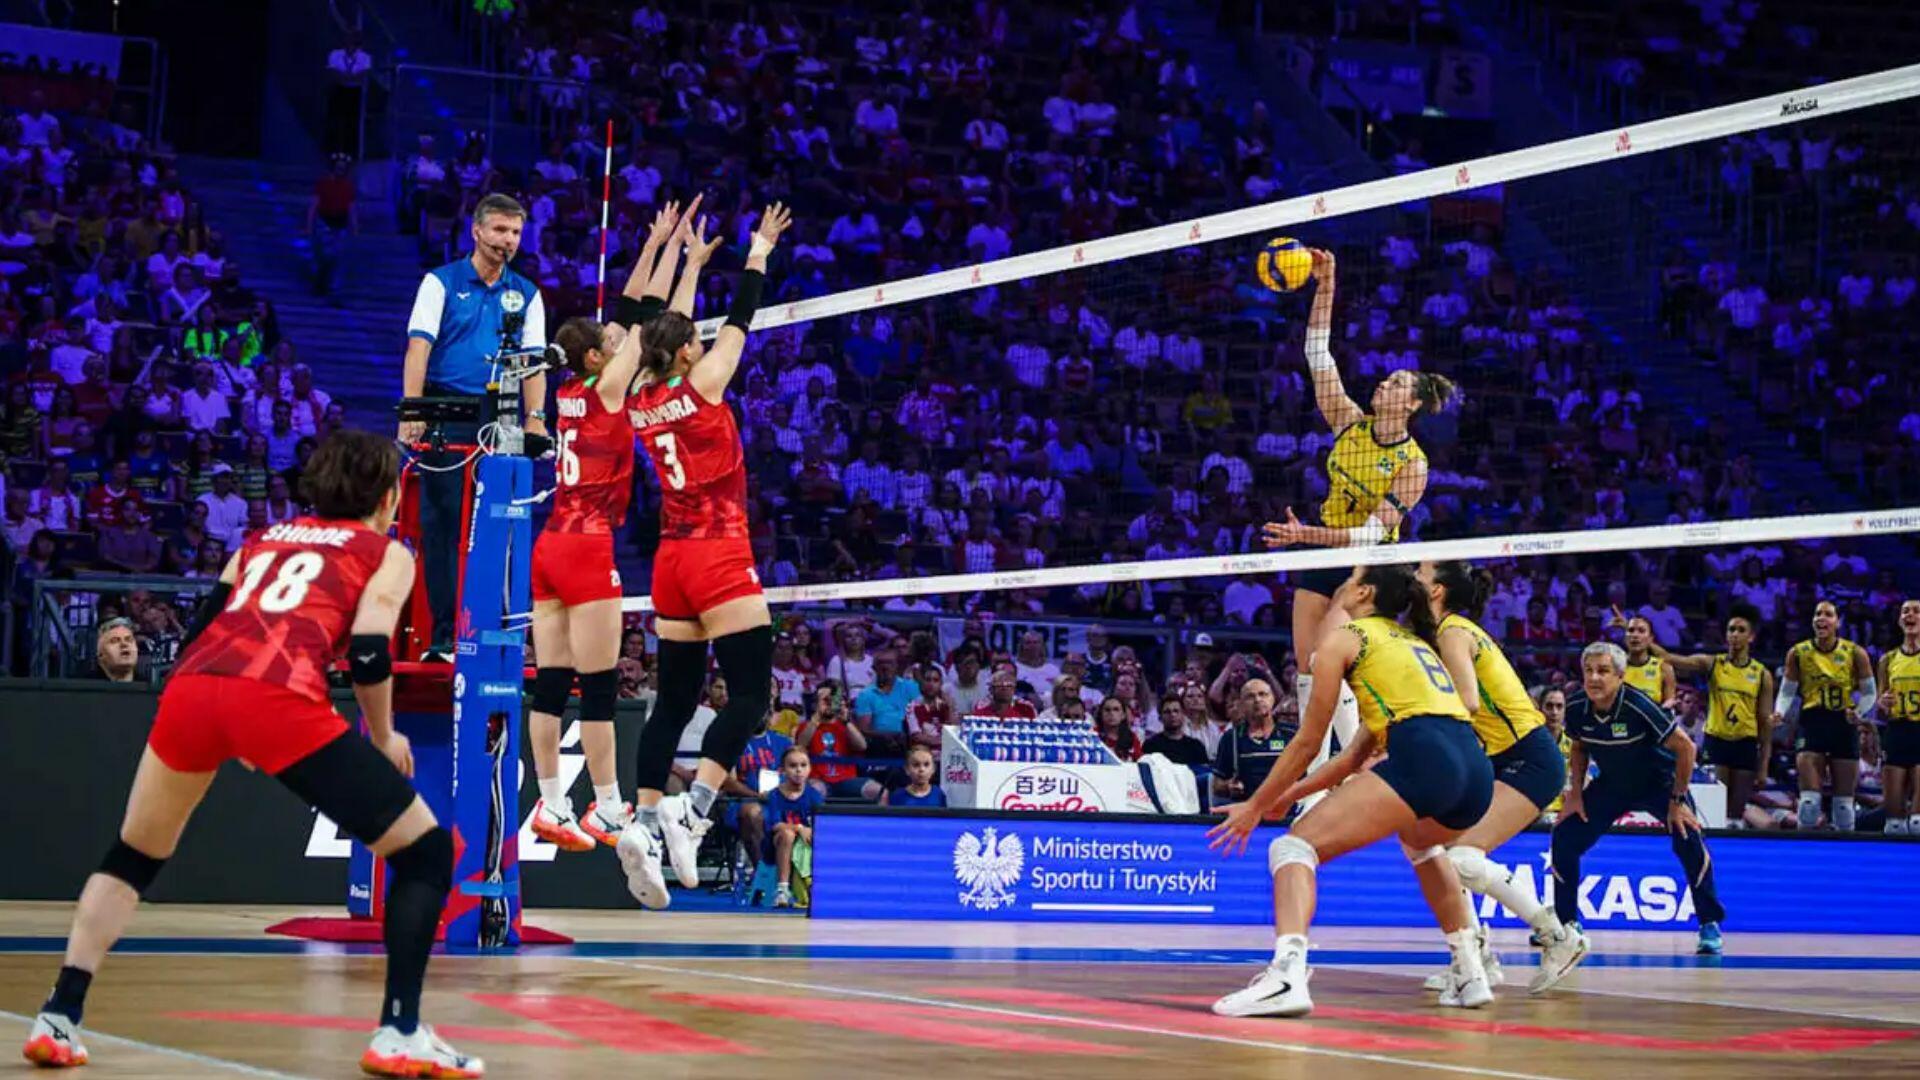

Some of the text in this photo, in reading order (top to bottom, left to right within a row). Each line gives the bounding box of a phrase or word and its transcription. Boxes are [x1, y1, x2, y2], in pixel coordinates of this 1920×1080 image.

[654, 432, 686, 490] 3
[225, 550, 325, 613] 18
[1819, 686, 1843, 710] 18
[1898, 690, 1920, 714] 15
[1725, 703, 1739, 725] 4
[1016, 775, 1080, 796] 百岁山
[1032, 837, 1172, 861] Ministerstwo
[1031, 866, 1216, 896] Sportu i Turystyki
